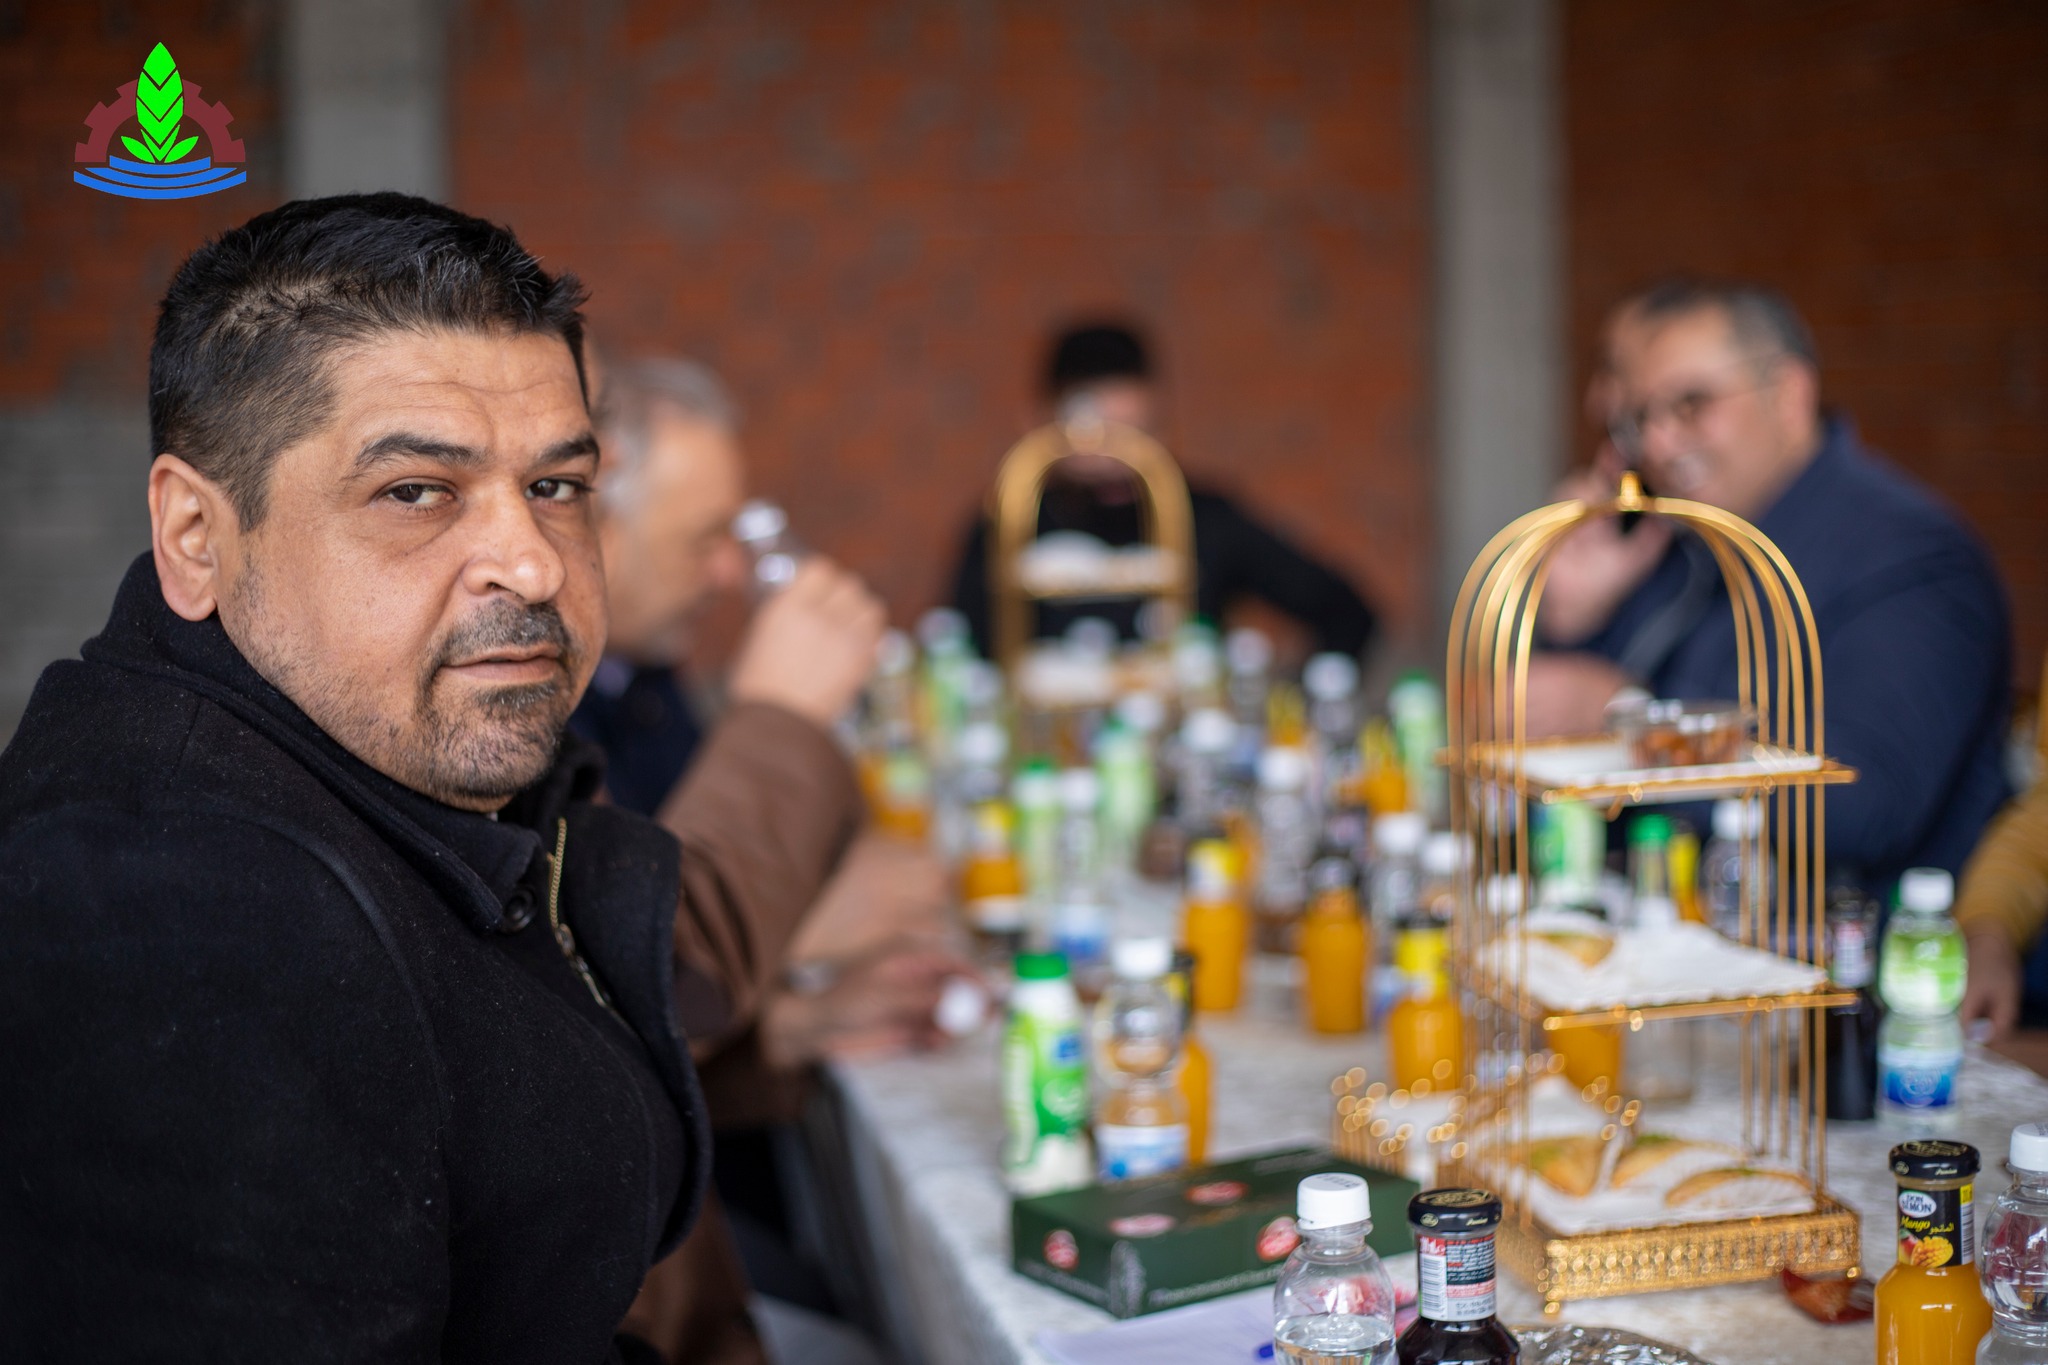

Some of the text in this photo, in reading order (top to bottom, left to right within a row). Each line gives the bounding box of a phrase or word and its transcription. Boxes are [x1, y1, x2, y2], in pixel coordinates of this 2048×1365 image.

[1906, 1194, 1924, 1203] DON
[1901, 1199, 1932, 1213] SIMON
[1901, 1216, 1931, 1233] Mango
